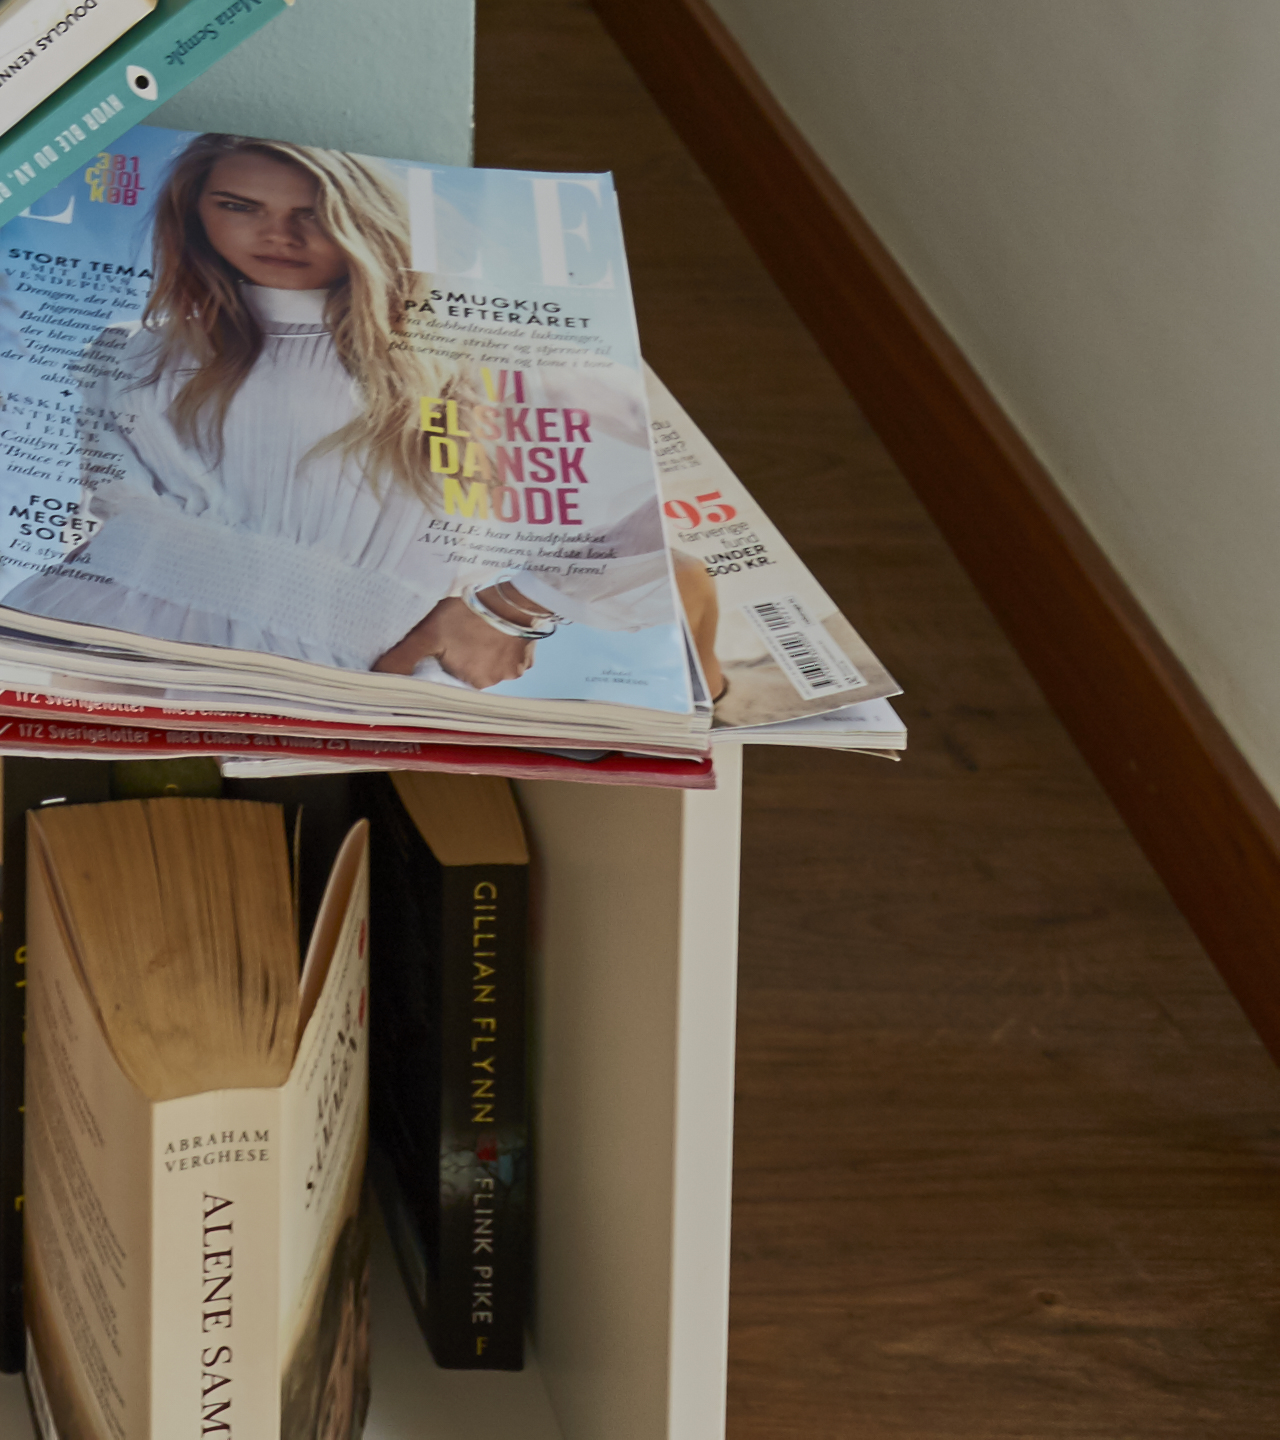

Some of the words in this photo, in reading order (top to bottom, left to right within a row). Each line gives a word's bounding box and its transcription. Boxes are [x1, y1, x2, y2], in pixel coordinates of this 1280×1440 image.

[9, 248, 83, 269] STORT
[89, 261, 153, 279] TEMA
[481, 367, 526, 403] VI
[419, 397, 593, 443] ELSKER
[430, 436, 588, 483] DANSK
[9, 506, 99, 534] MEGET
[29, 495, 80, 514] FOR
[443, 478, 583, 526] MODE
[664, 491, 736, 530] 95
[19, 522, 84, 547] SOL?
[472, 882, 498, 1004] GILLIAN
[471, 1018, 496, 1124] FLYNN
[165, 1129, 270, 1154] ABRAHAM
[165, 1149, 270, 1172] VERGHESE
[475, 1176, 495, 1256] FLINK
[471, 1265, 494, 1325] PIKE
